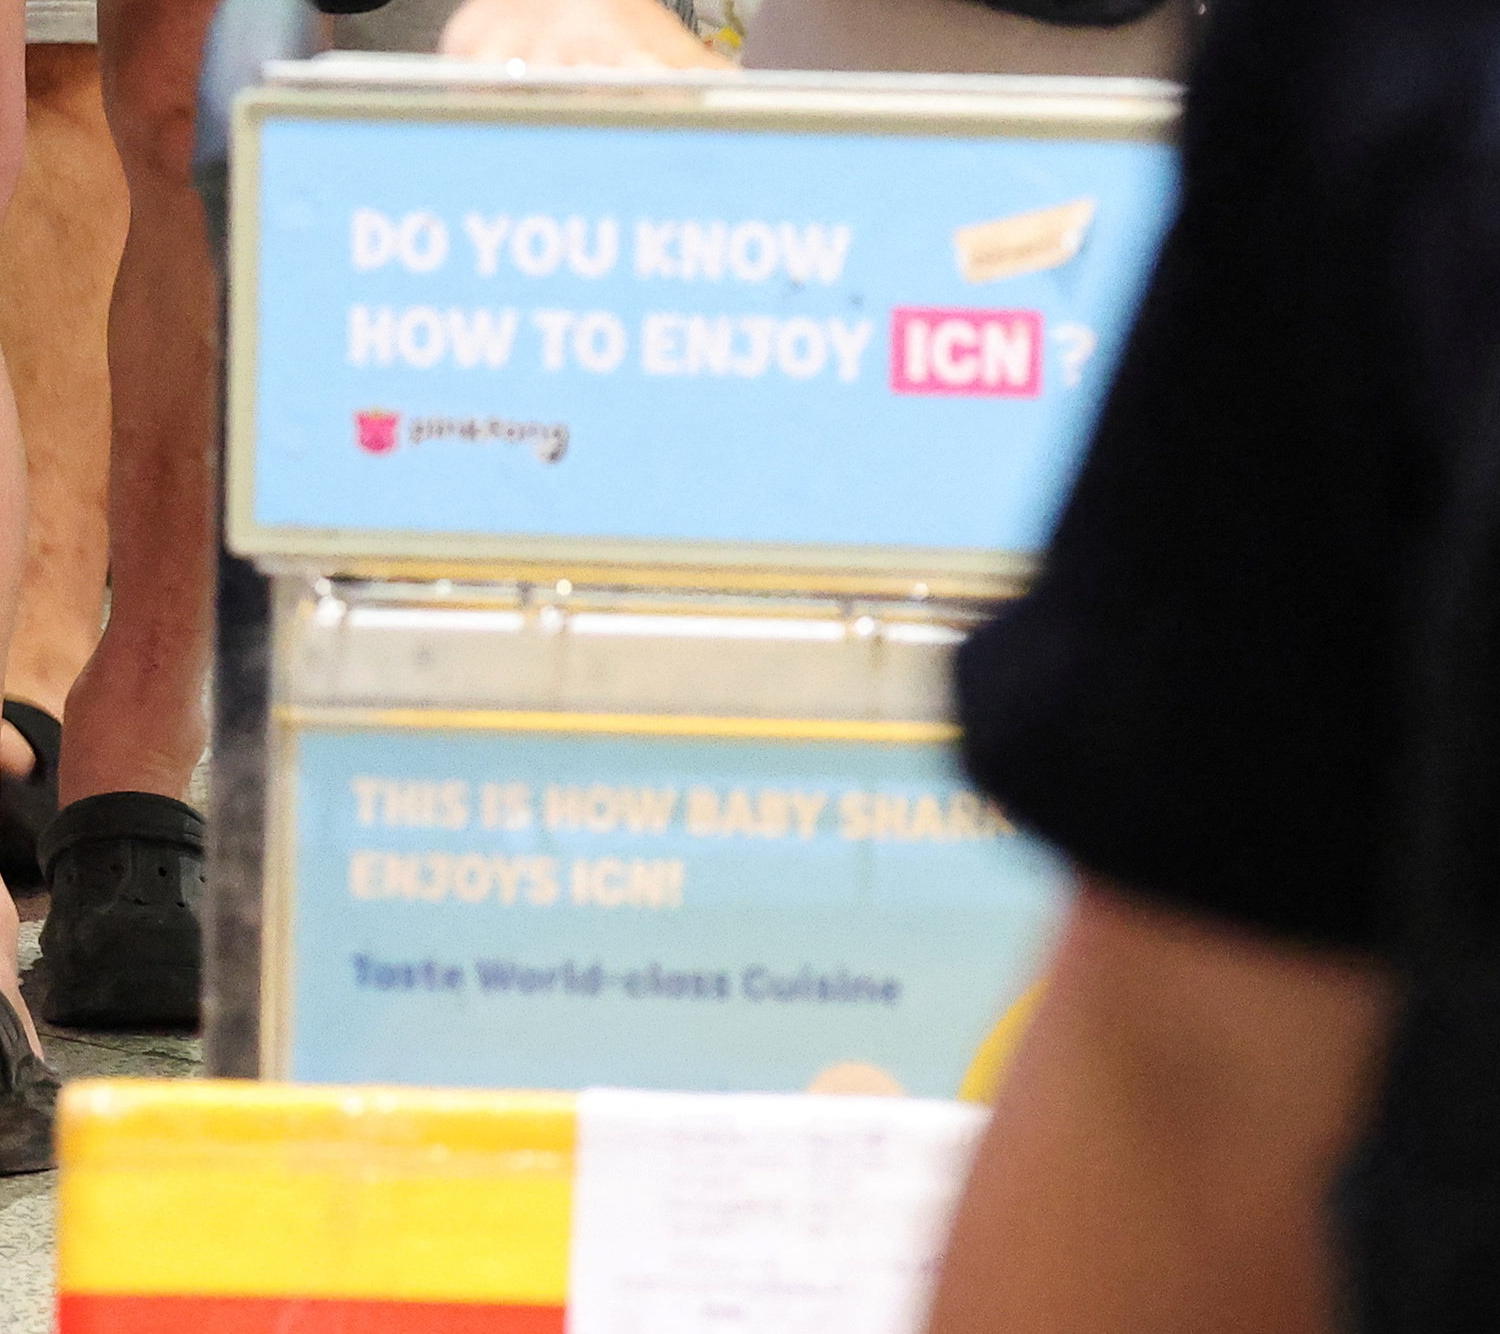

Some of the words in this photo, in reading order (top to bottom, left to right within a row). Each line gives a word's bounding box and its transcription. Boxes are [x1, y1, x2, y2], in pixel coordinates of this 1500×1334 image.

[351, 206, 449, 273] DO
[465, 211, 620, 278] YOU
[635, 218, 852, 286] KNOW
[348, 303, 518, 368] HOW
[533, 308, 628, 373] TO
[640, 311, 872, 381] ENJOY
[904, 319, 1032, 386] ICN
[351, 776, 470, 831] THIS
[480, 780, 534, 832] IS
[544, 782, 676, 836] HOW
[687, 783, 830, 841] BABY
[351, 849, 559, 907] ENJOYS
